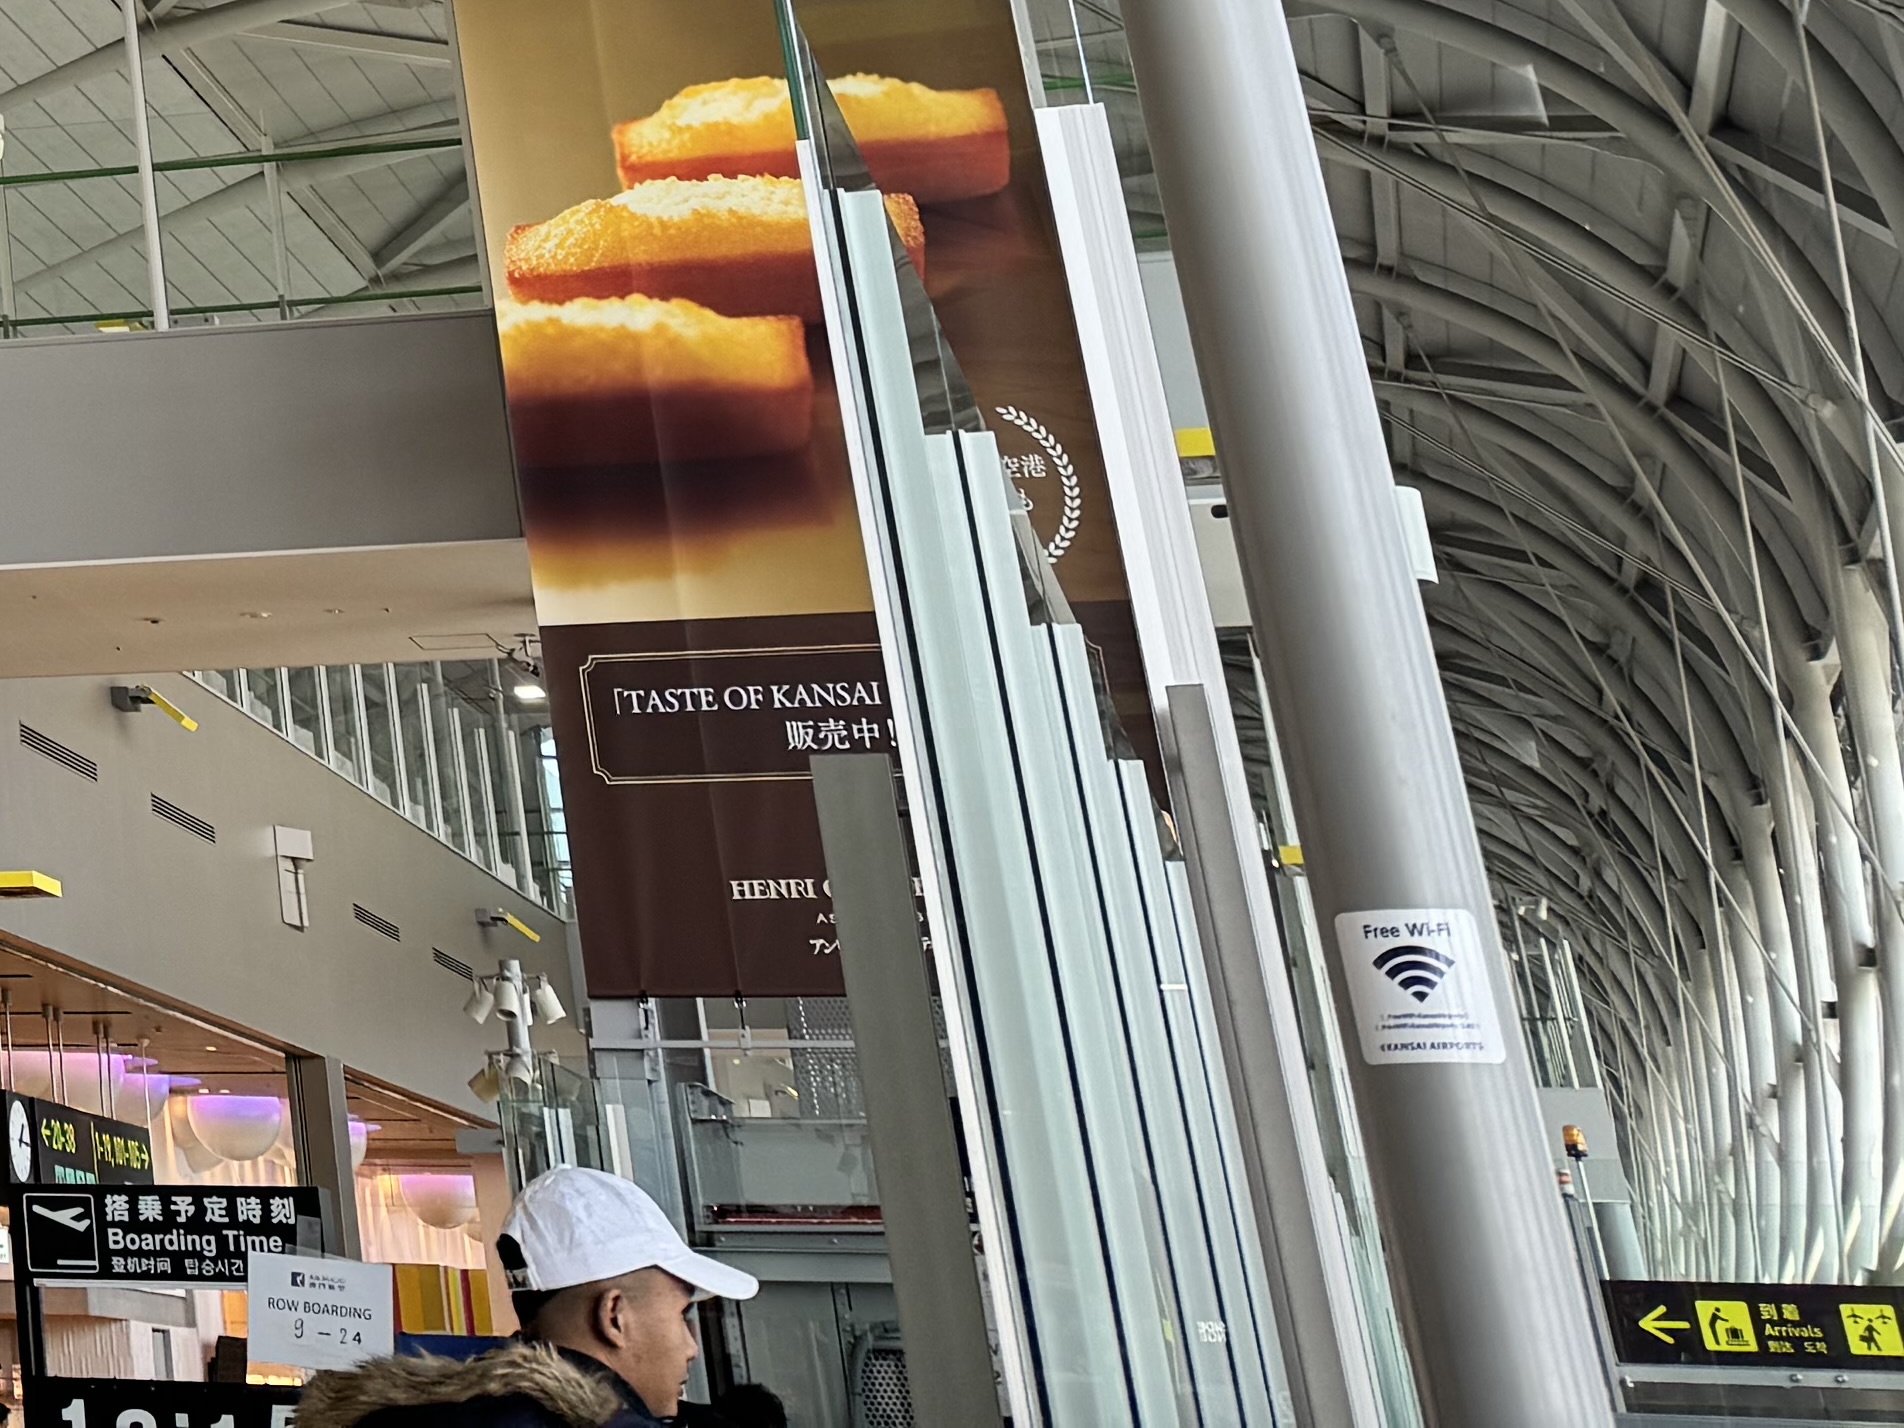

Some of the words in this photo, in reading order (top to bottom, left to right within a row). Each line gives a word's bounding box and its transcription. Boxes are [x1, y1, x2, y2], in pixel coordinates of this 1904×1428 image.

[723, 685, 764, 711] OF
[769, 681, 882, 709] KANSAI
[729, 878, 818, 900] HENRI
[1363, 924, 1400, 940] Free
[1404, 921, 1452, 938] Wi-Fi
[104, 1194, 296, 1225] 搭乗予定時刻
[107, 1227, 216, 1257] Boarding
[221, 1229, 283, 1254] Time
[267, 1297, 299, 1312] ROW
[303, 1301, 372, 1321] BOARDING
[294, 1318, 304, 1339] 9
[339, 1327, 362, 1345] 24
[1765, 1323, 1824, 1338] Arrivals
